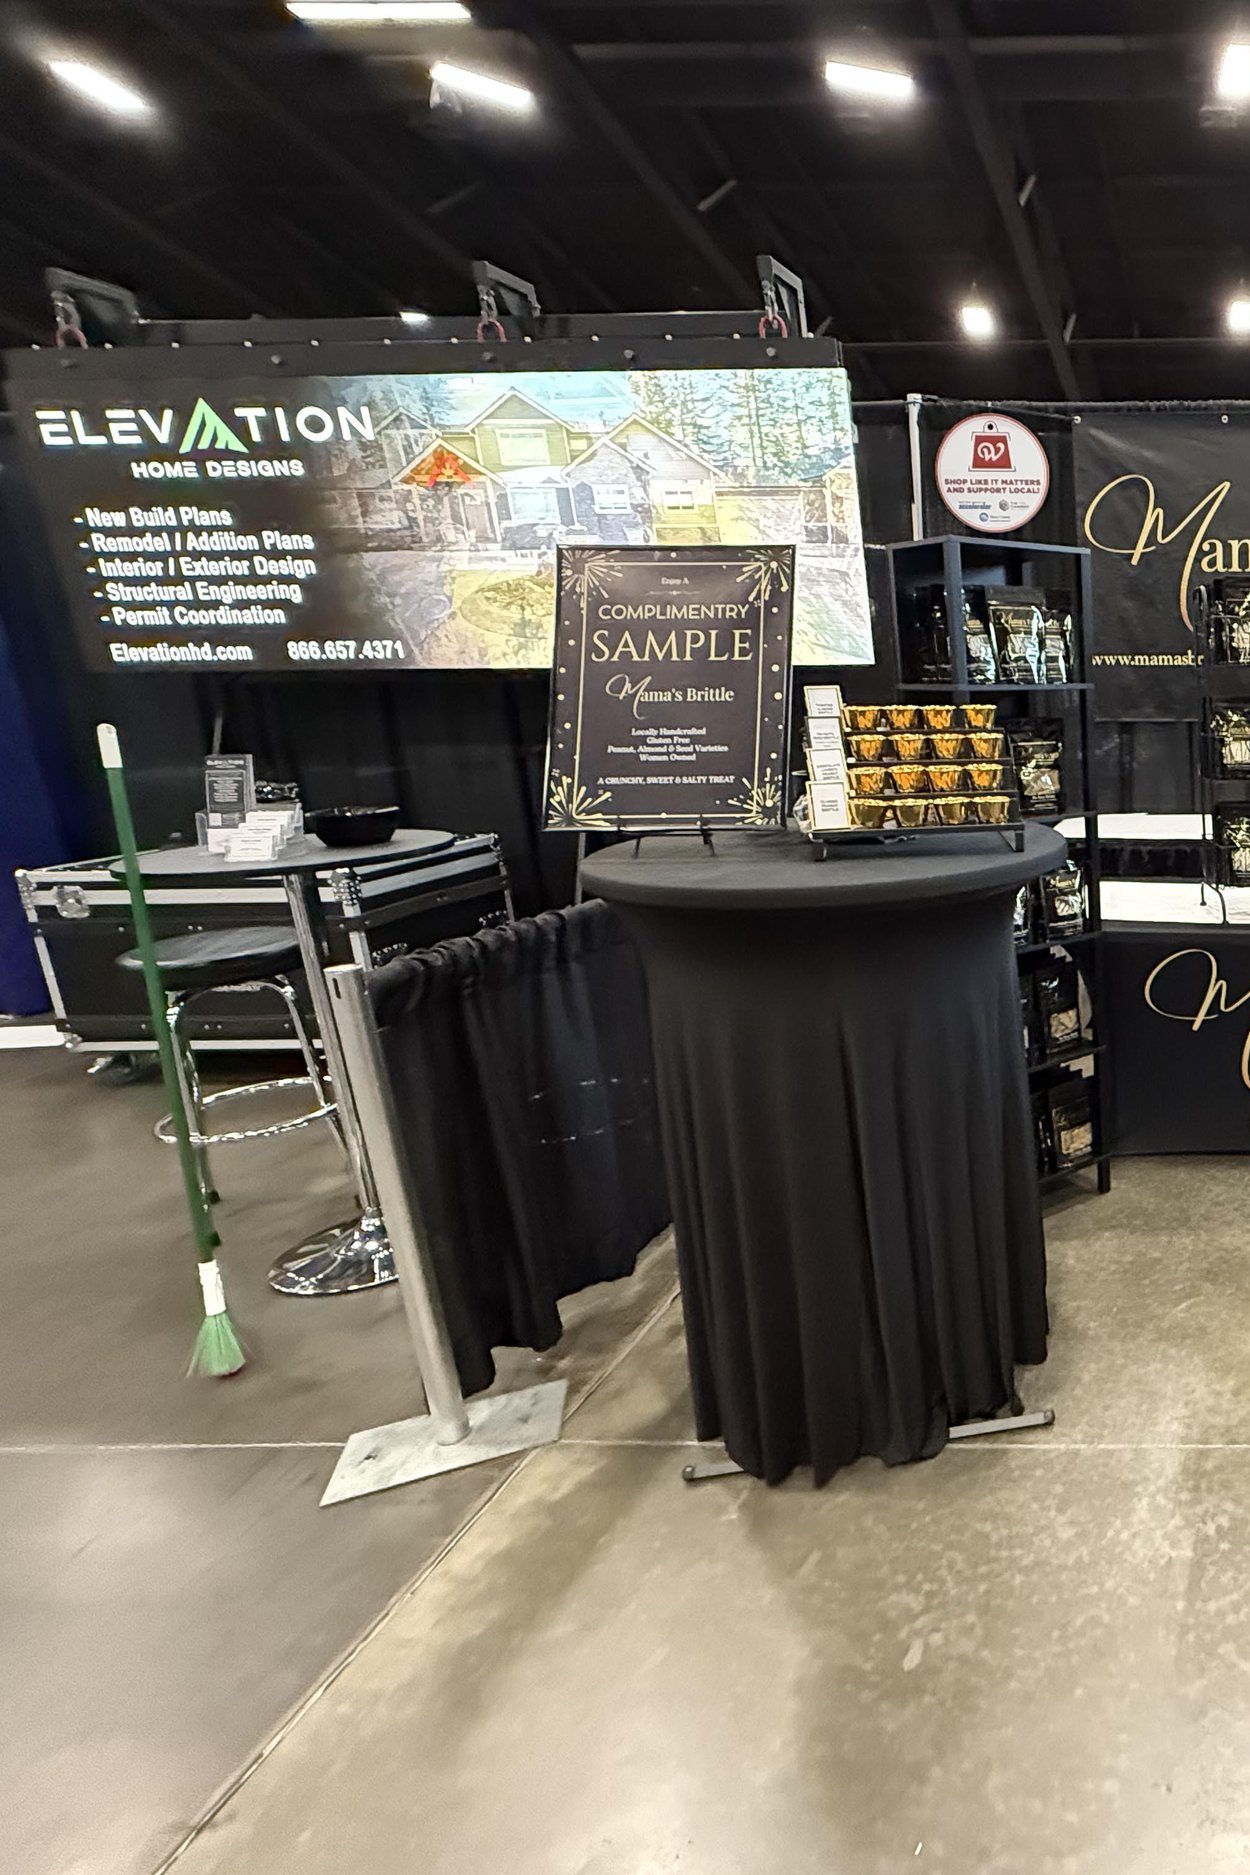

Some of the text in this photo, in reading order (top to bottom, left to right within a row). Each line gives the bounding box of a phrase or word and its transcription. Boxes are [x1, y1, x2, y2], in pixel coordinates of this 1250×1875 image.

[35, 397, 376, 453] ELEVATION
[131, 459, 305, 479] HOME DESIGNS
[85, 507, 126, 527] New
[131, 506, 177, 527] Build
[181, 506, 232, 527] Plans
[91, 533, 170, 553] Remodel
[186, 532, 259, 551] Addition
[264, 531, 314, 550] Plans
[99, 558, 165, 577] Interior
[180, 557, 250, 576] Exterior
[254, 556, 317, 579] Design
[105, 582, 192, 602] Structural
[197, 581, 302, 605] Engineering
[112, 607, 172, 627] Permit
[174, 606, 286, 626] Coordination
[598, 604, 750, 620] COMPLIMENTRY
[110, 640, 405, 663] Elevationhd.com 866.657.4371
[591, 629, 753, 663] SAMPLE
[605, 673, 734, 720] Mama's Brittle
